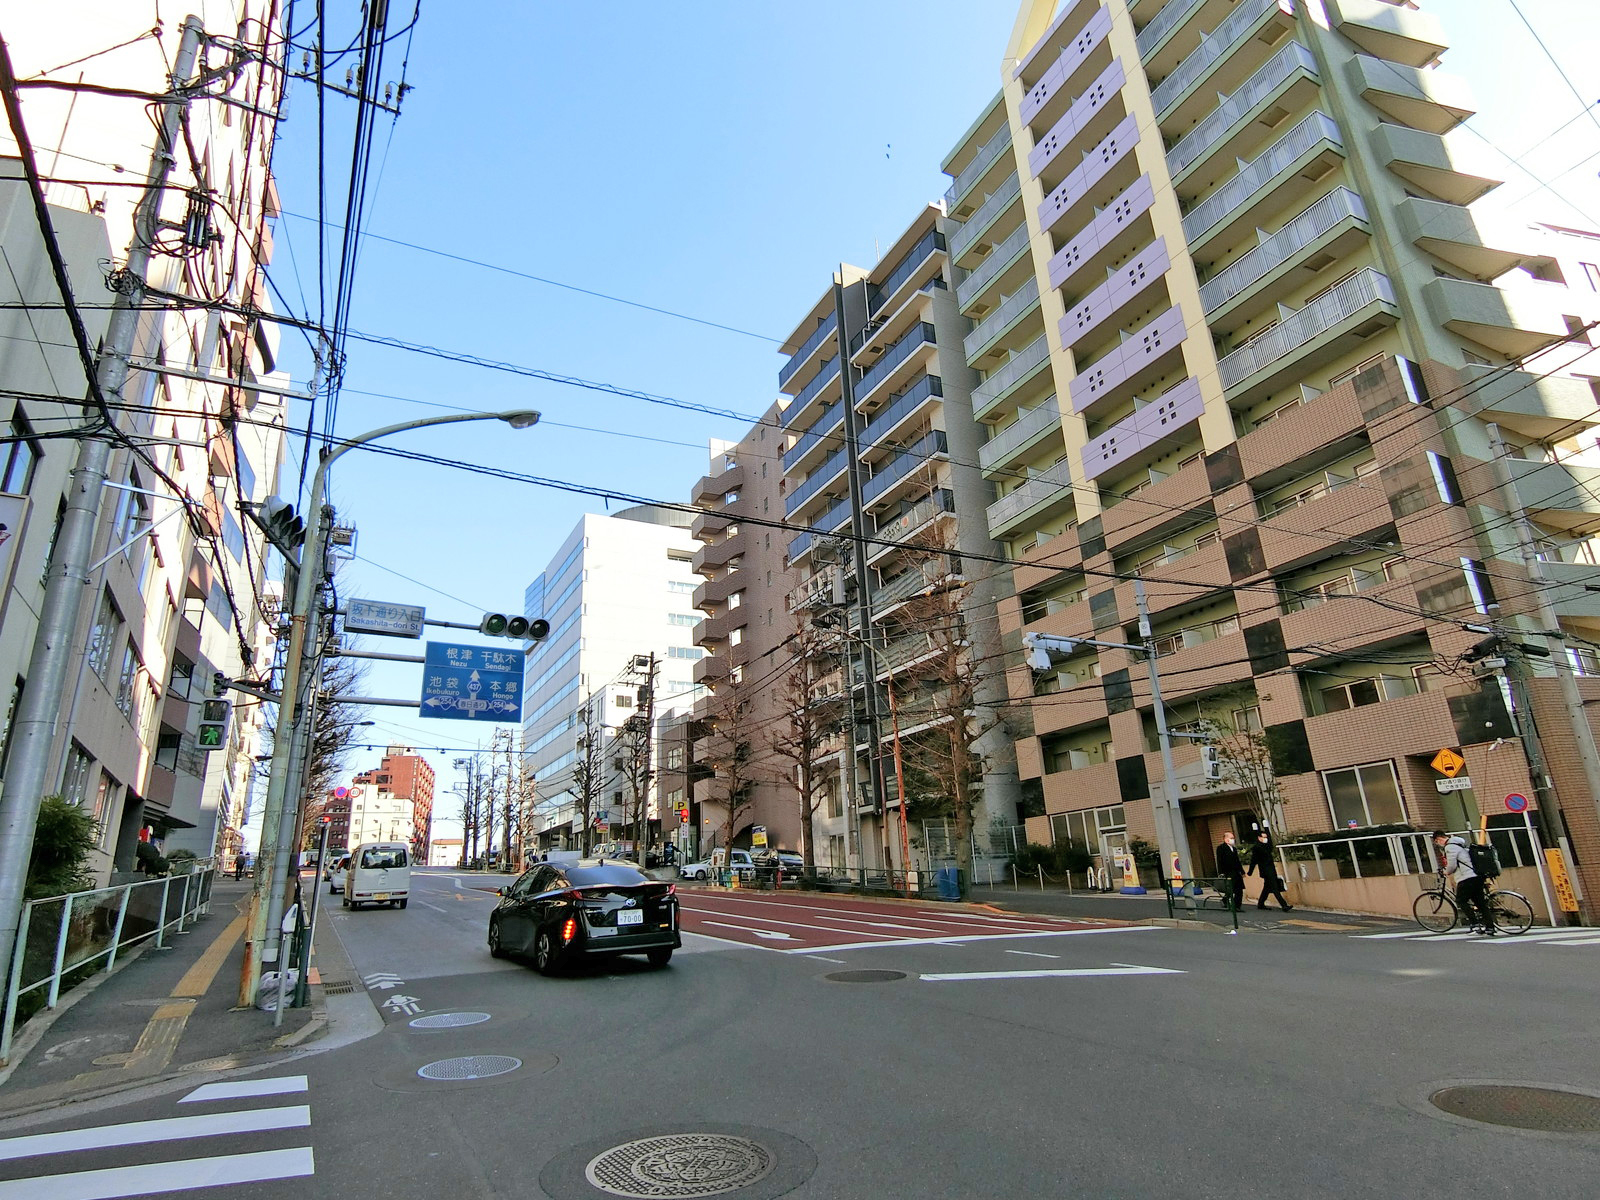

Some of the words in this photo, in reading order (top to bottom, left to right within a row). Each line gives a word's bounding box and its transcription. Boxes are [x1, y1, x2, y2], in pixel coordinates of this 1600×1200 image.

[352, 603, 421, 622] 坂下通り入口
[351, 616, 408, 629] Sakashita-dori
[410, 623, 420, 631] St.
[446, 648, 473, 660] 根津
[481, 651, 516, 664] 千駄木
[485, 663, 511, 671] Sendagi
[429, 676, 459, 688] 池袋
[489, 680, 517, 693] 本郷
[426, 687, 460, 696] Ikebukuro
[492, 692, 514, 700] Hongo
[460, 700, 485, 708] 春日通り
